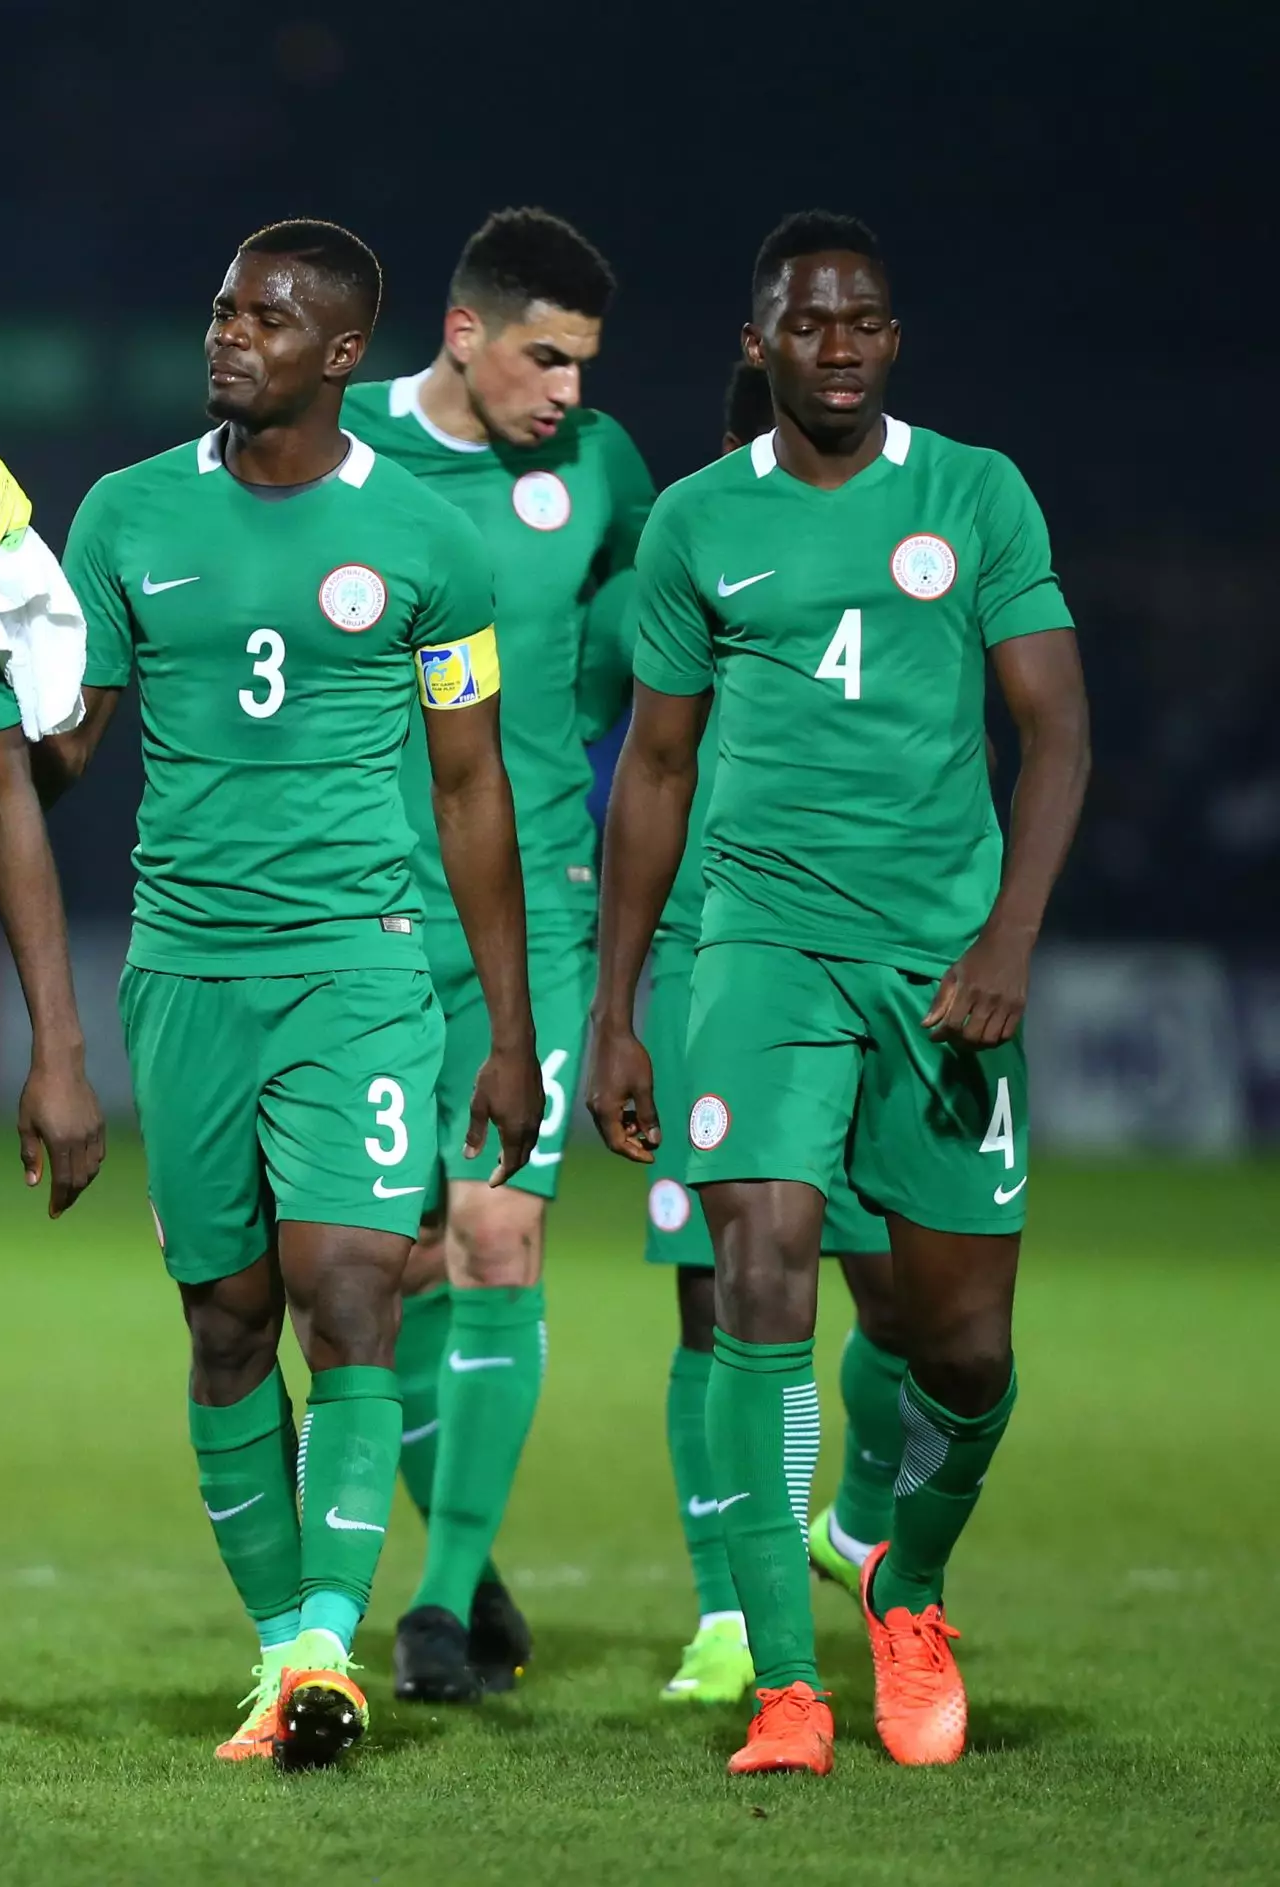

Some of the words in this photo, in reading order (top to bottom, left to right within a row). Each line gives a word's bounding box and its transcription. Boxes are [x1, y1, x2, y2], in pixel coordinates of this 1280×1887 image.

[324, 587, 336, 617] NIGERIA
[328, 568, 366, 586] FOOTBALL
[367, 575, 383, 619] FEDERATION
[341, 618, 366, 627] ABUJA
[815, 609, 862, 699] 4
[238, 628, 285, 719] 3
[459, 692, 476, 703] FIFA
[365, 1077, 409, 1167] 3
[538, 1049, 567, 1137] 6
[980, 1077, 1015, 1170] 4
